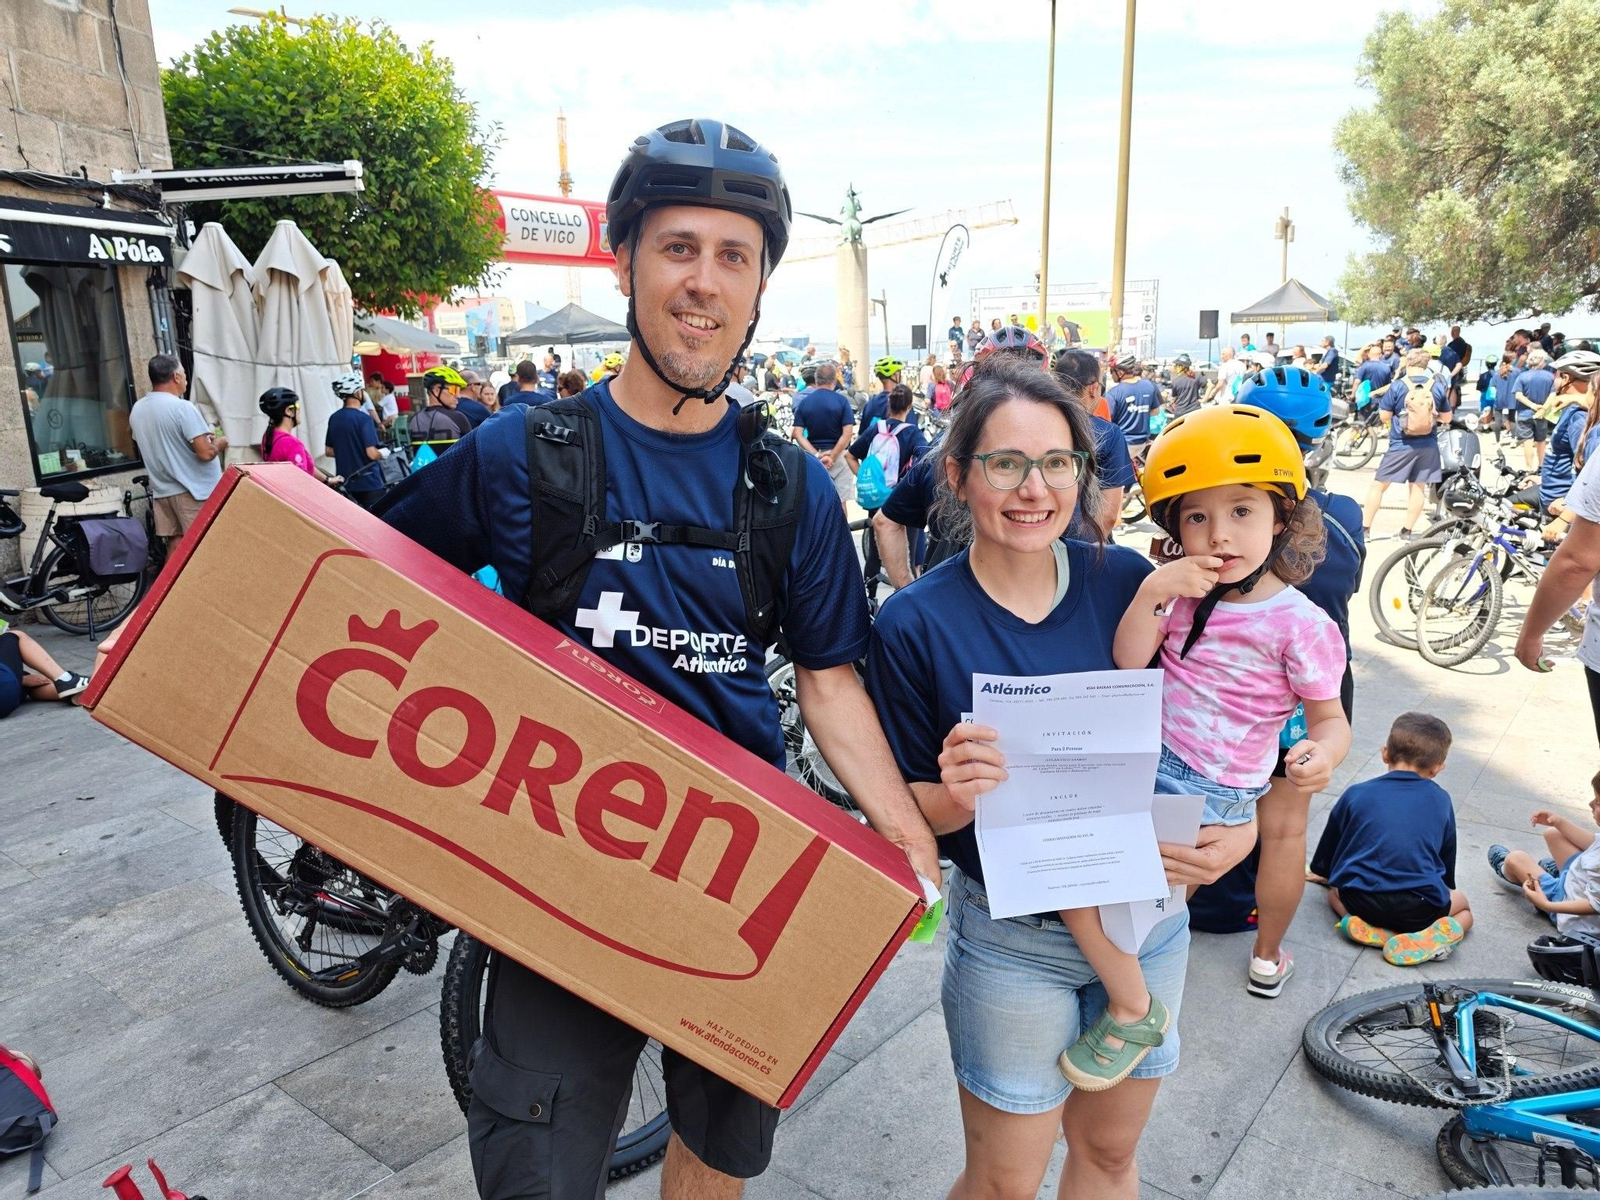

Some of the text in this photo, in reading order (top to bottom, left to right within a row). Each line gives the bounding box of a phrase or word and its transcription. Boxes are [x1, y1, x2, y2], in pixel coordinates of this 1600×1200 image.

[511, 208, 582, 227] CONCELLO
[521, 227, 575, 244] DE VIGO
[712, 556, 726, 567] DÍA
[630, 624, 748, 654] DEPORTE
[980, 682, 1052, 695] Atlántico
[680, 1018, 772, 1075] www.atendacoren.es
[706, 1020, 779, 1066] HAZ TU PEDIDO EN
